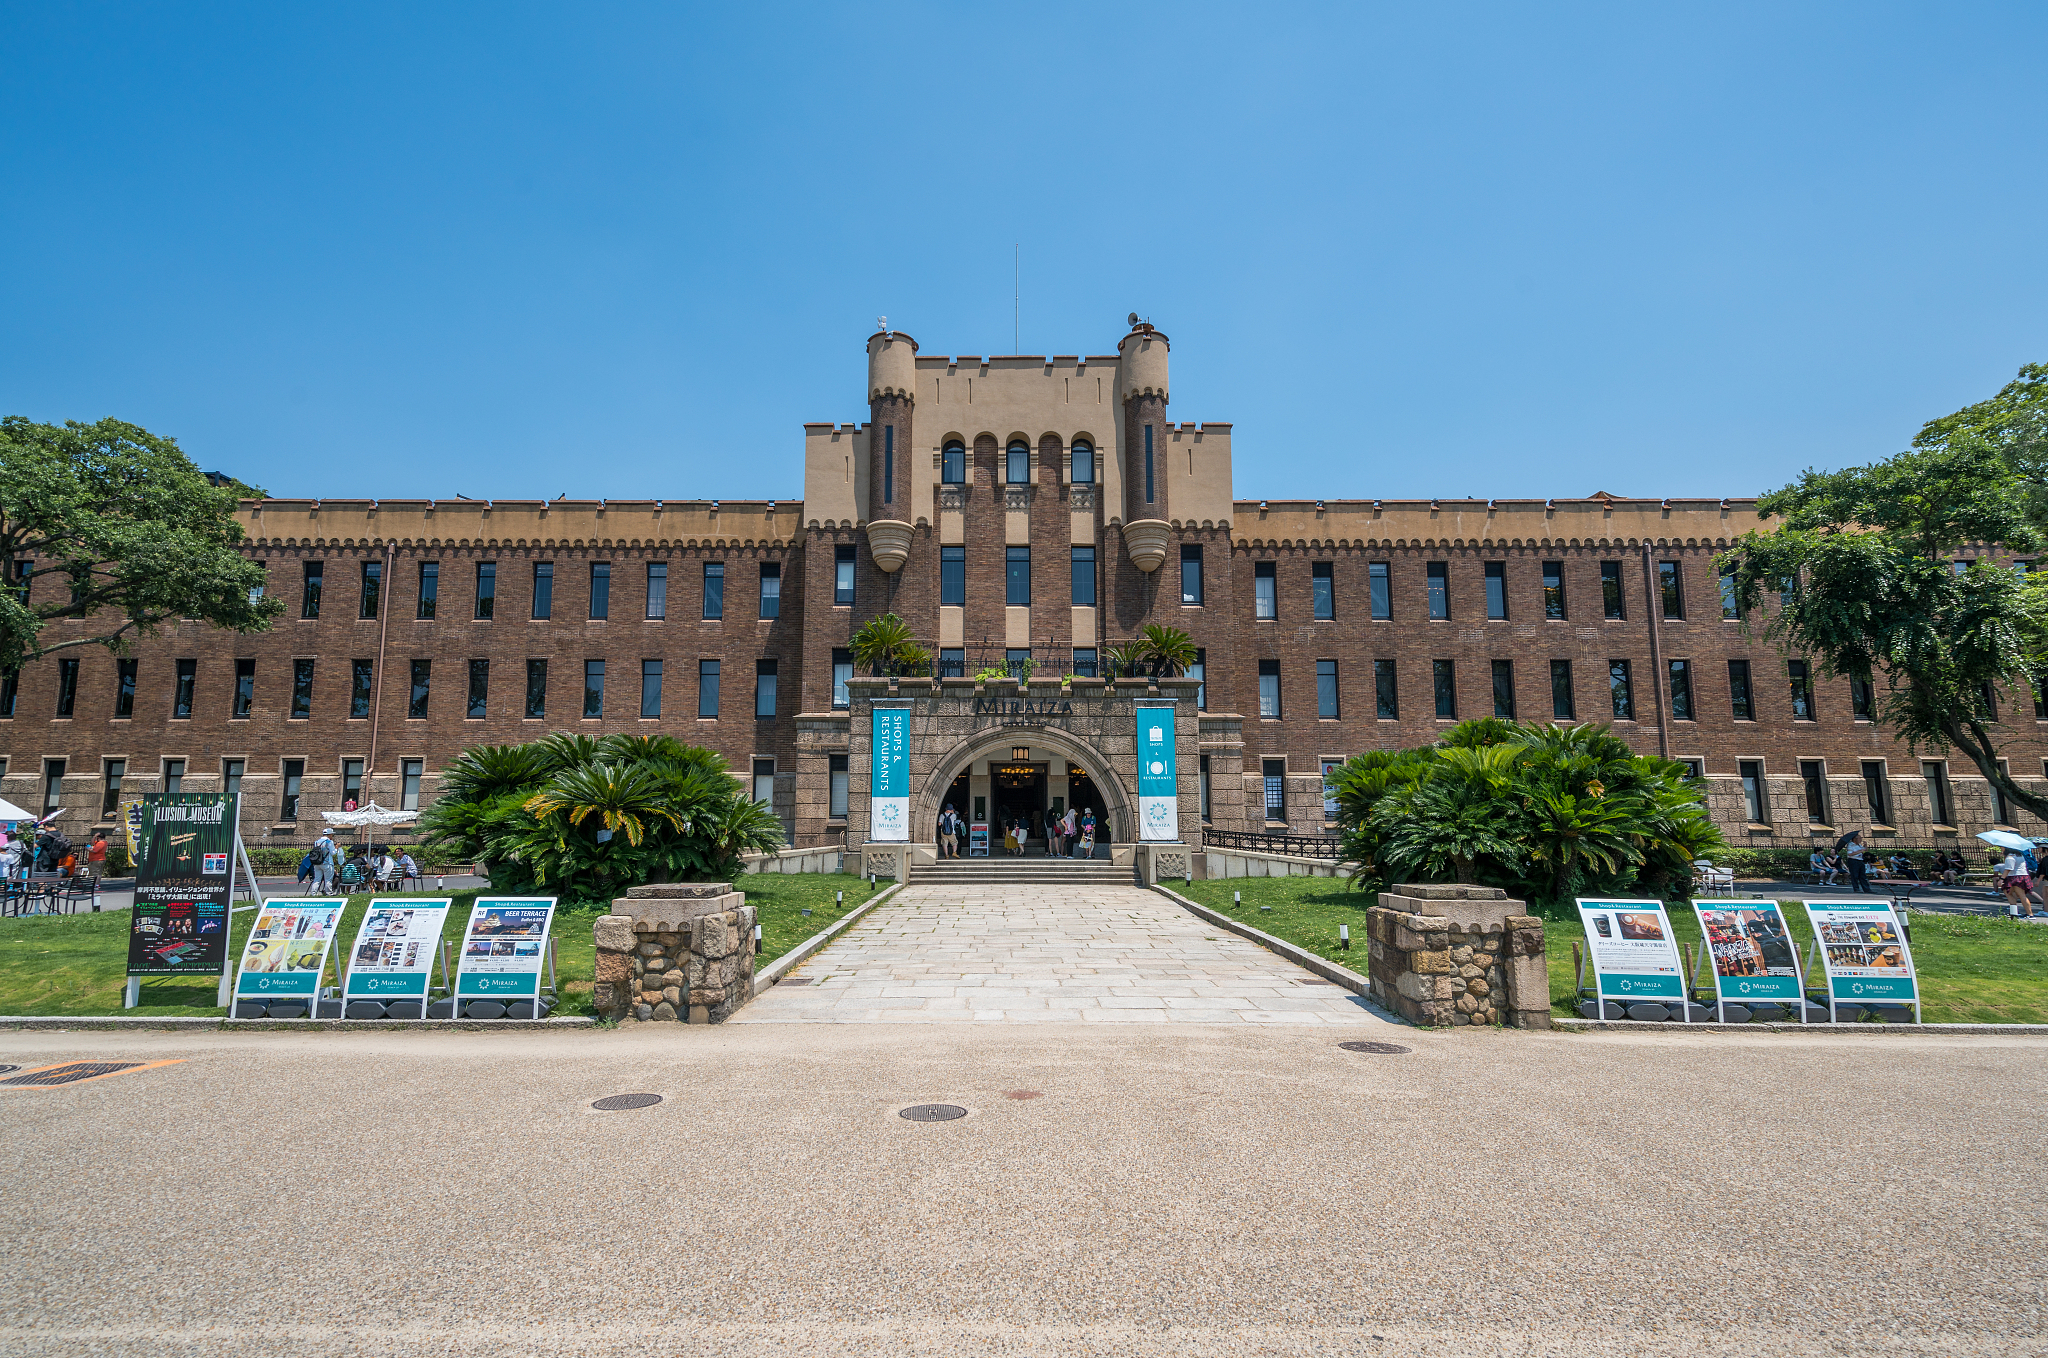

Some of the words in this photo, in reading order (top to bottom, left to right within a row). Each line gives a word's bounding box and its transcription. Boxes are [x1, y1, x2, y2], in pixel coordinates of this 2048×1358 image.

[976, 697, 1073, 715] MIRAIZA
[893, 716, 902, 751] SHOPS
[880, 716, 890, 791] RESTAURANTS
[893, 755, 902, 763] &
[190, 806, 222, 822] MUSEUM
